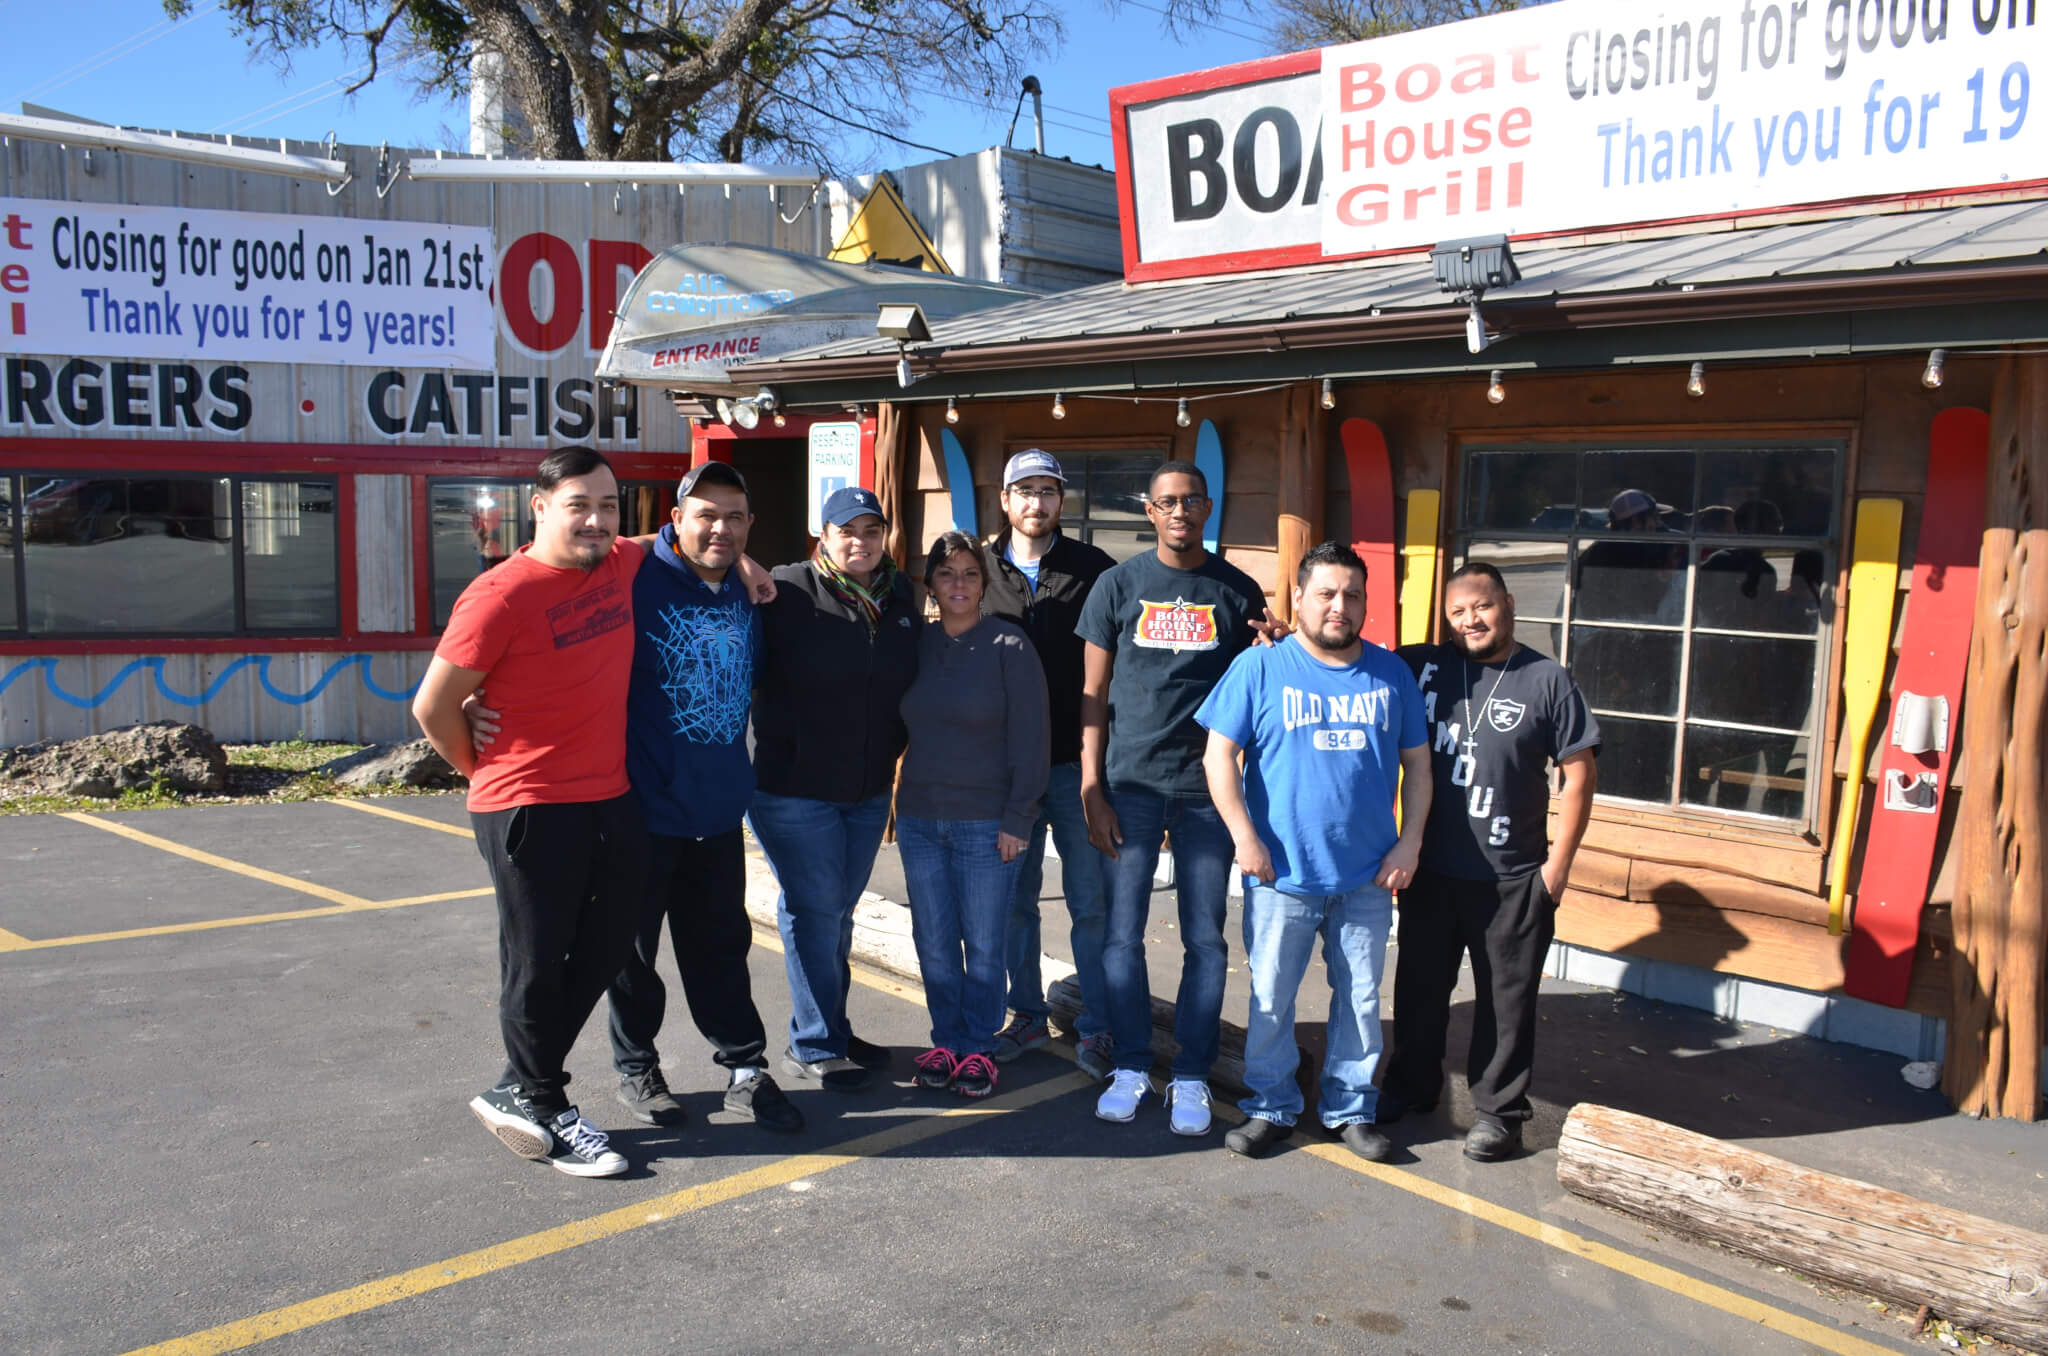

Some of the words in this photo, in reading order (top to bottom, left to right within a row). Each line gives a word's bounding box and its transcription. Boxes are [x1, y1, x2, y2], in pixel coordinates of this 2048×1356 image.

[1566, 13, 1721, 101] Closing
[1741, 0, 1807, 73] for
[1340, 42, 1542, 114] Boat
[1342, 106, 1533, 173] House
[1597, 104, 1735, 188] Thank
[1754, 106, 1841, 178] you
[1864, 79, 1941, 156] for
[1963, 61, 2030, 144] 19
[1336, 161, 1525, 228] Grill
[52, 216, 167, 287] Closing
[178, 222, 222, 277] for
[233, 228, 305, 292] good
[317, 243, 352, 283] on
[362, 235, 411, 286] Jan
[423, 238, 484, 291] 21st
[648, 290, 795, 315] CONDITIONED
[678, 273, 727, 293] AIR
[81, 287, 182, 336] Thank
[192, 303, 249, 348] you
[261, 295, 305, 341] for
[318, 299, 352, 343] 19
[364, 305, 455, 355] years!
[652, 336, 761, 368] ENTRANCE
[367, 370, 638, 440] CATFISH
[815, 452, 854, 466] PARKING
[1148, 620, 1206, 633] HOUSE
[1150, 630, 1202, 642] GRILL
[1156, 611, 1198, 623] BOAT
[1283, 686, 1322, 731] OLD
[1328, 687, 1389, 732] NAVY
[1328, 731, 1351, 748] 94
